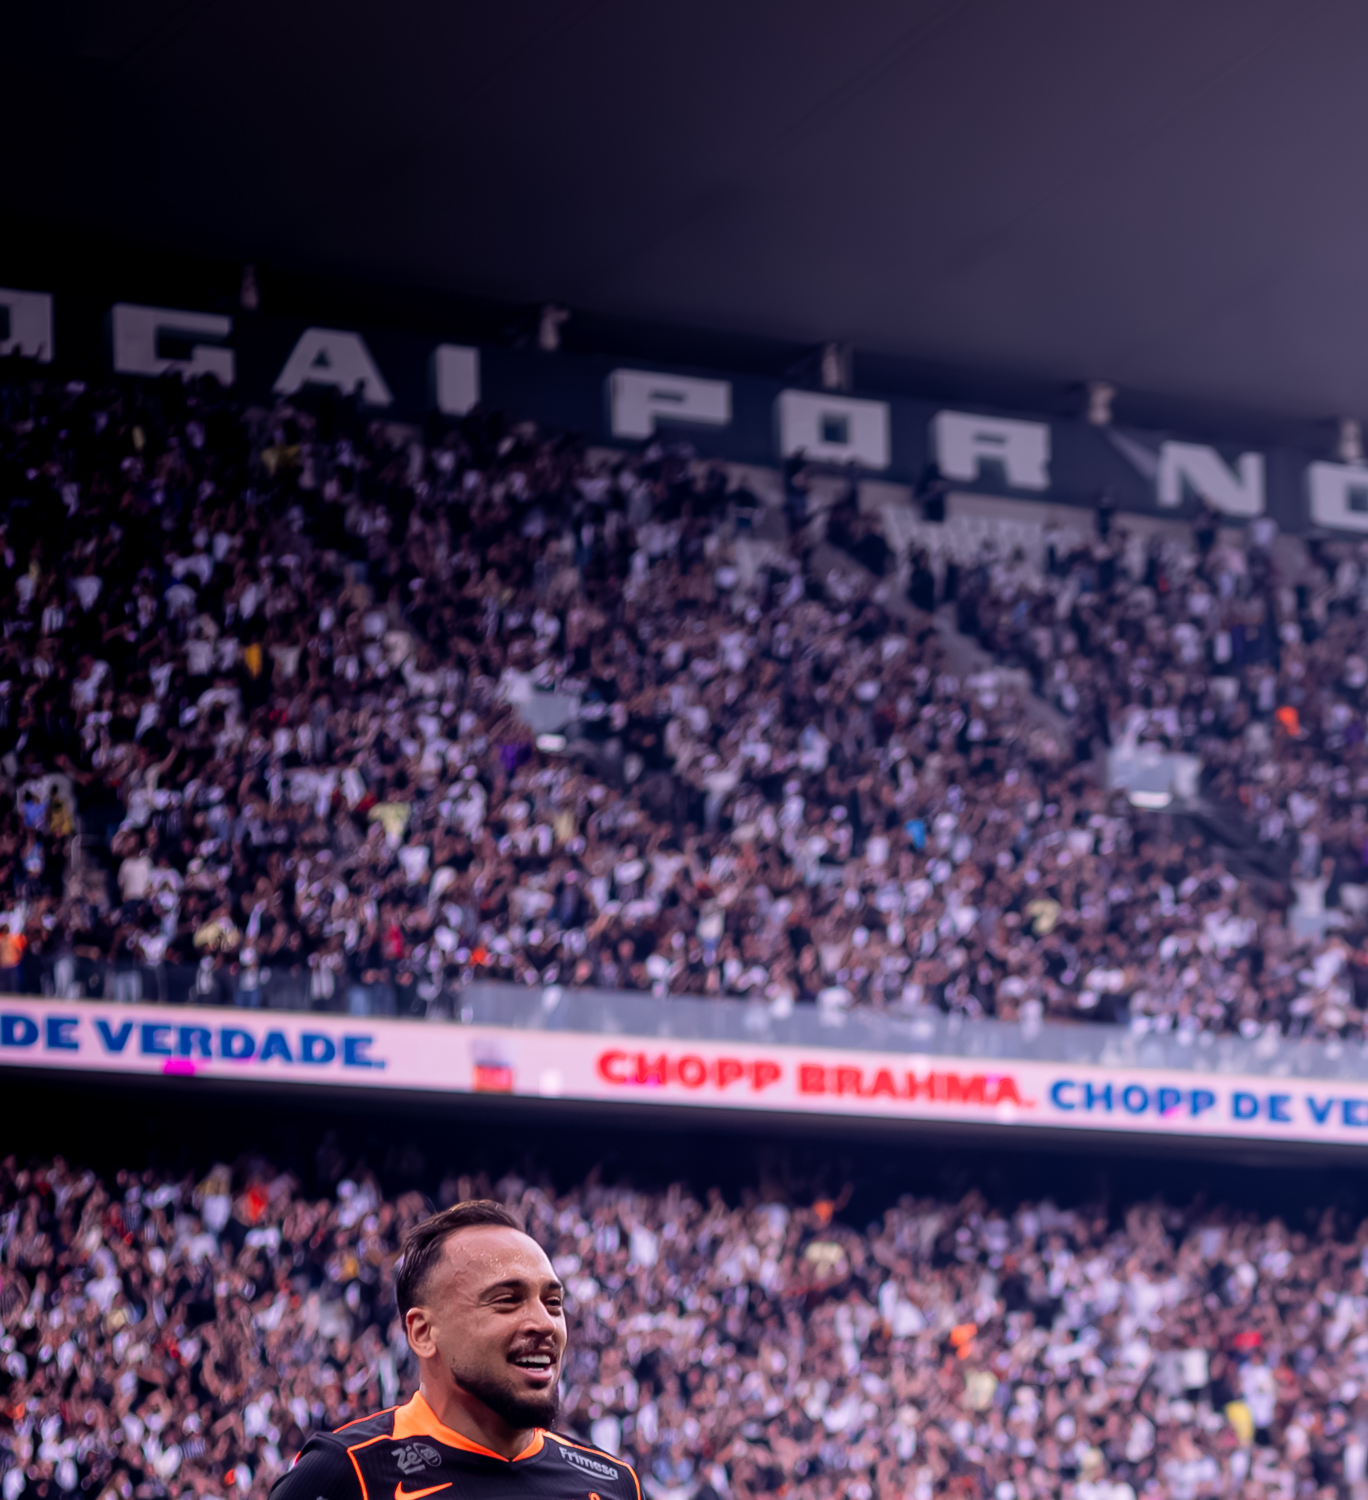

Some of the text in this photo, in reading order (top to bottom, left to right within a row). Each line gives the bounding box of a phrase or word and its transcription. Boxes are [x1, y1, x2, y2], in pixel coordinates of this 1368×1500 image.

[609, 367, 1051, 490] POR
[0, 1014, 80, 1051] DE
[597, 1050, 783, 1092] CHOPP
[1049, 1079, 1217, 1117] CHOPP
[1231, 1091, 1293, 1123] DE
[559, 1446, 619, 1479] Frimesa
